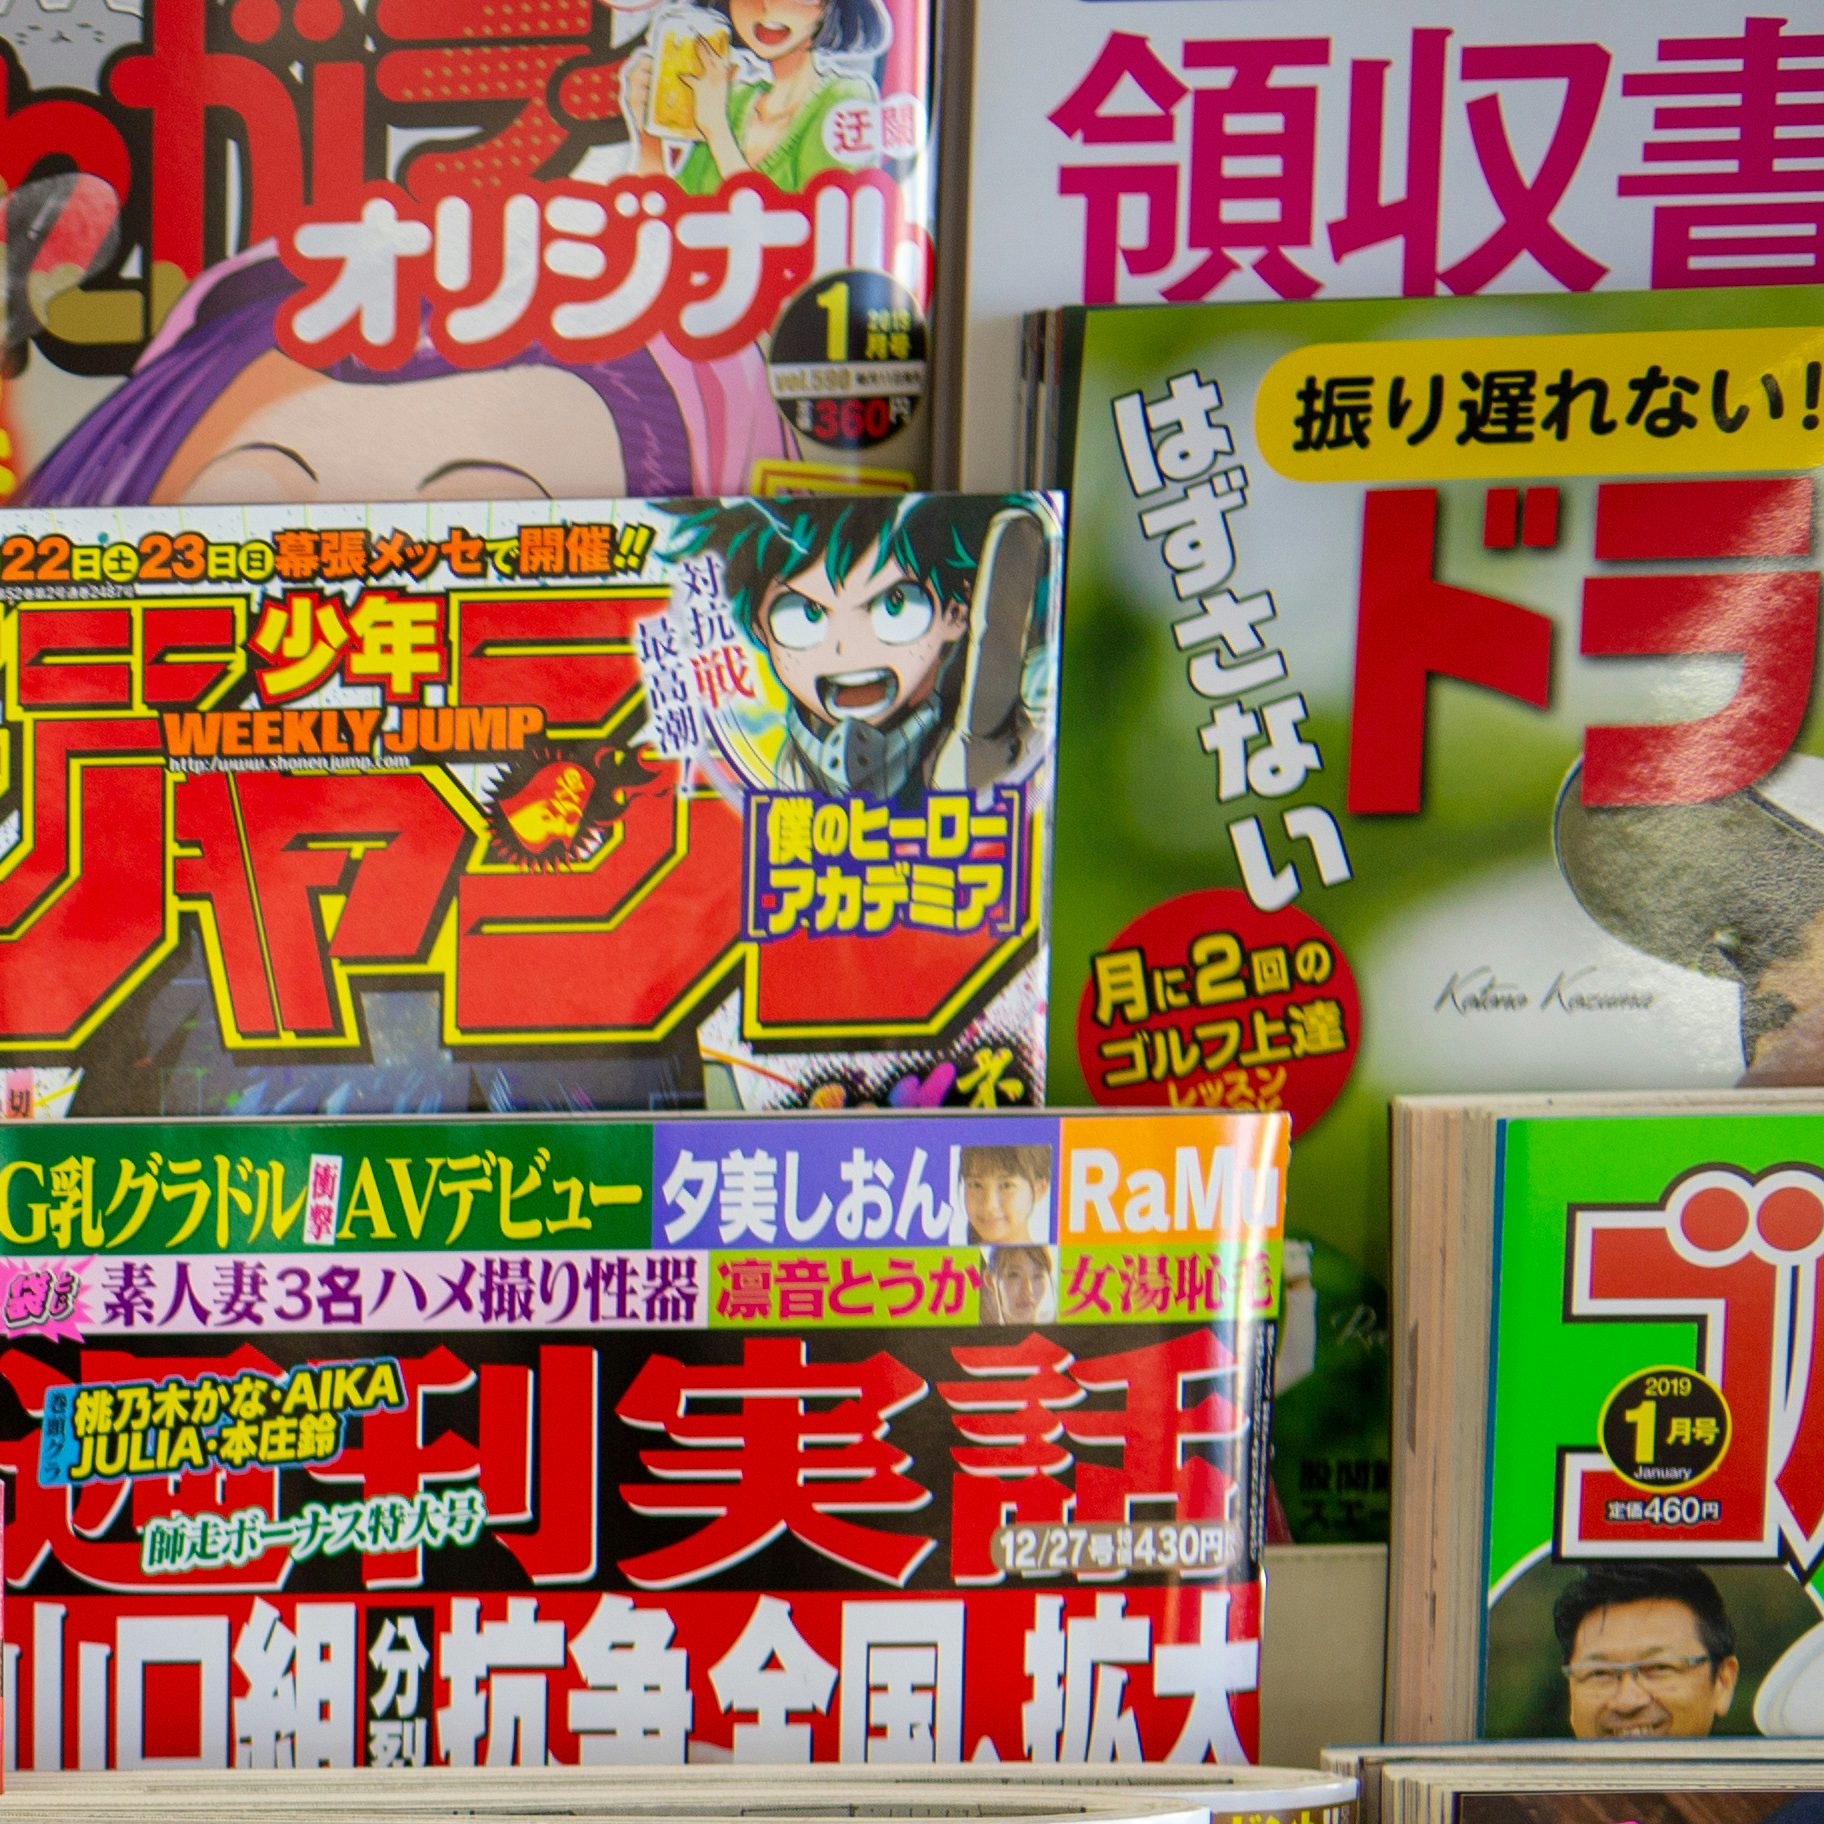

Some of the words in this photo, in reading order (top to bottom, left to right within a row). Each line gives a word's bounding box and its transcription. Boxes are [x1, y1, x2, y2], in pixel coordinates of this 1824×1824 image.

[252, 588, 444, 705] 少年
[680, 556, 758, 708] 対抗戦
[1110, 368, 1353, 914] はずさない
[164, 707, 381, 756] WEEKLY
[384, 705, 546, 755] JUMP
[765, 862, 1008, 937] アカデミア
[1090, 928, 1333, 1028] 月に2回の
[1100, 998, 1348, 1090] ゴルフ上達
[335, 1146, 644, 1245] AVデビュー
[661, 1147, 954, 1247] 夕美しおん
[1069, 1146, 1280, 1237] RaMu
[101, 1255, 699, 1329] 素人妻3名ハメ撮り性器
[1643, 1376, 1692, 1397] 2019
[1633, 1462, 1693, 1483] January
[143, 1489, 488, 1571] 師走ボーナス特大号
